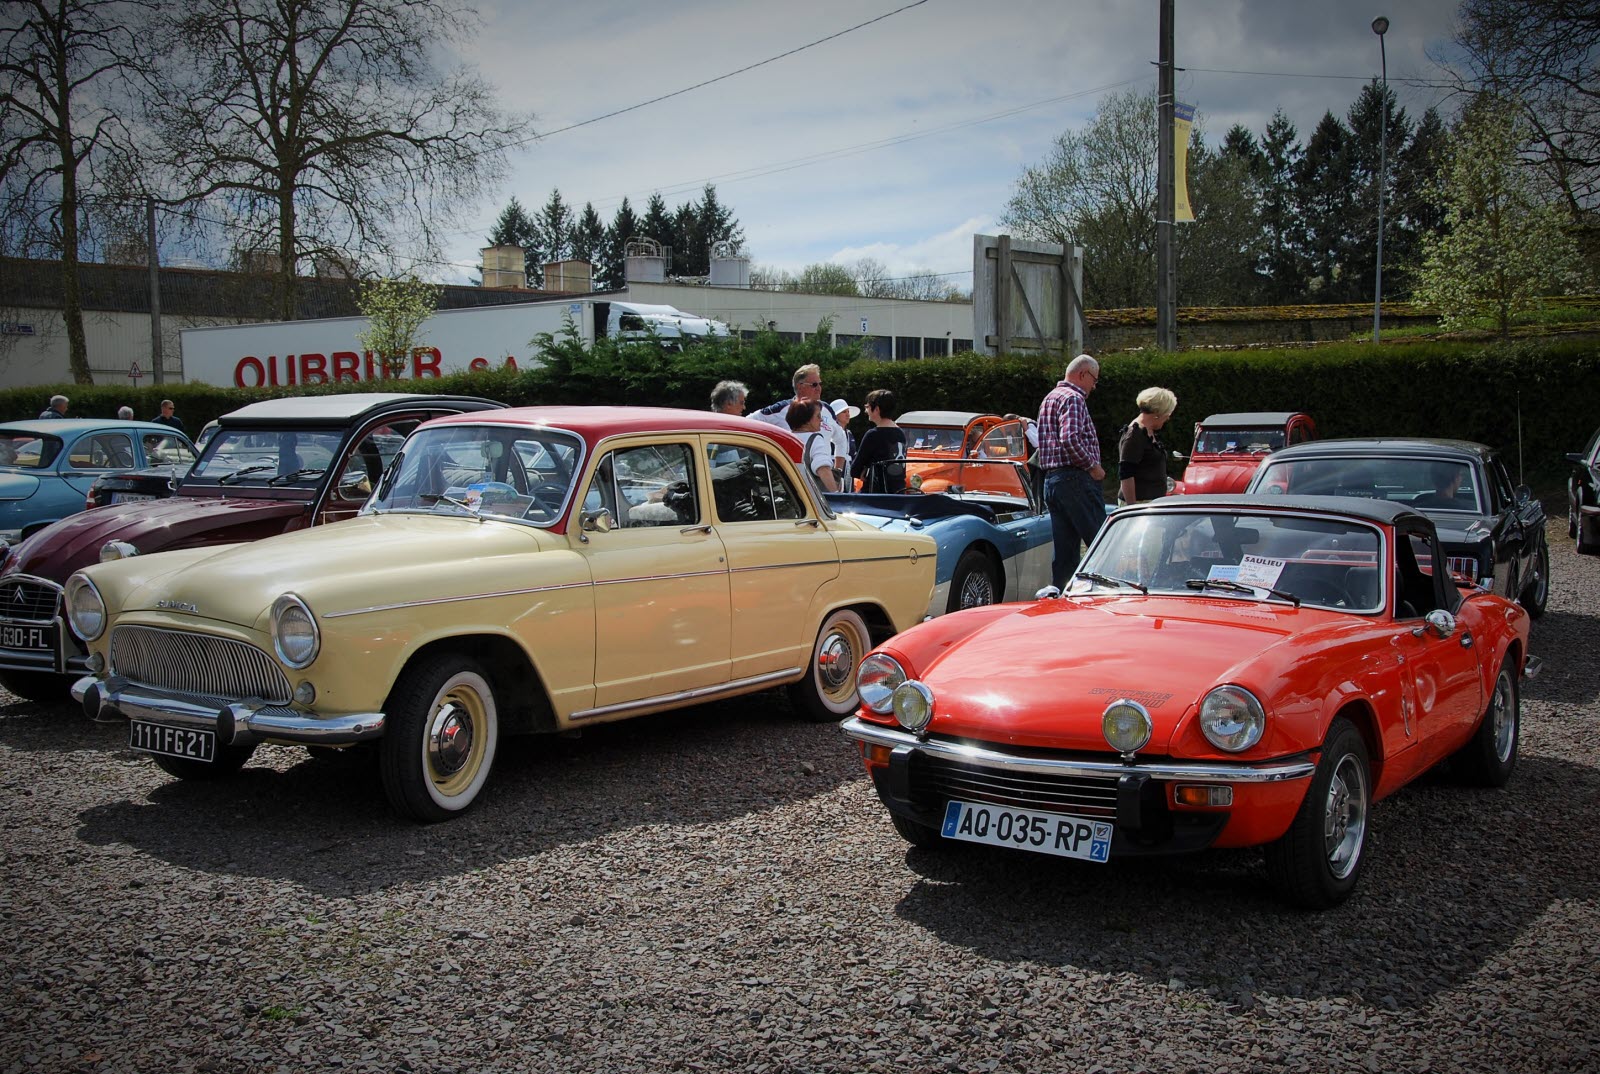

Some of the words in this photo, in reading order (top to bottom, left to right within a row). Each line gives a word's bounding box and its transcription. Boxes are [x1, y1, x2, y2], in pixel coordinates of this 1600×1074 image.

[1244, 556, 1283, 568] SAULIEU
[136, 724, 205, 757] 111FG21
[947, 823, 953, 831] F
[958, 808, 1092, 852] AQ-035-RP
[1091, 843, 1107, 858] 21
